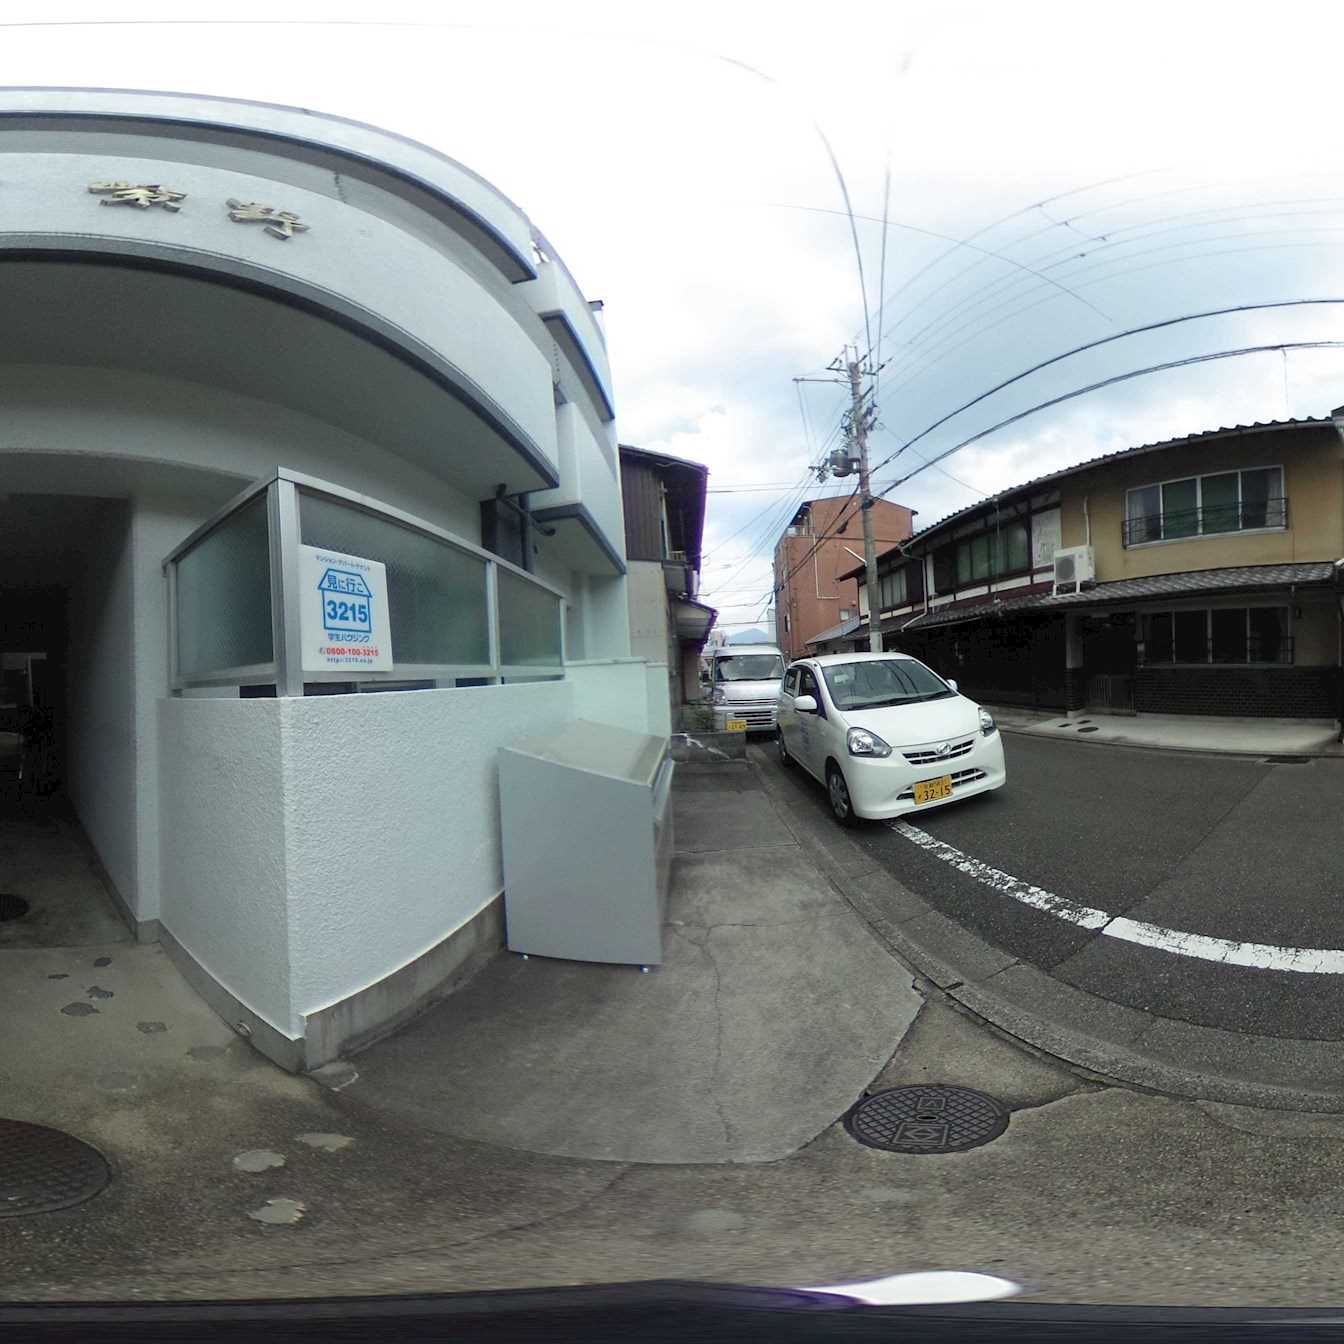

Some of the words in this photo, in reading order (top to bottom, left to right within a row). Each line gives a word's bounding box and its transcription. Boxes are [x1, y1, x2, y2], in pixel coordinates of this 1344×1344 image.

[327, 574, 365, 593] 見に行こ
[326, 600, 368, 623] 3215
[326, 647, 379, 657] 0800-100-3215
[923, 785, 951, 800] 32-15
